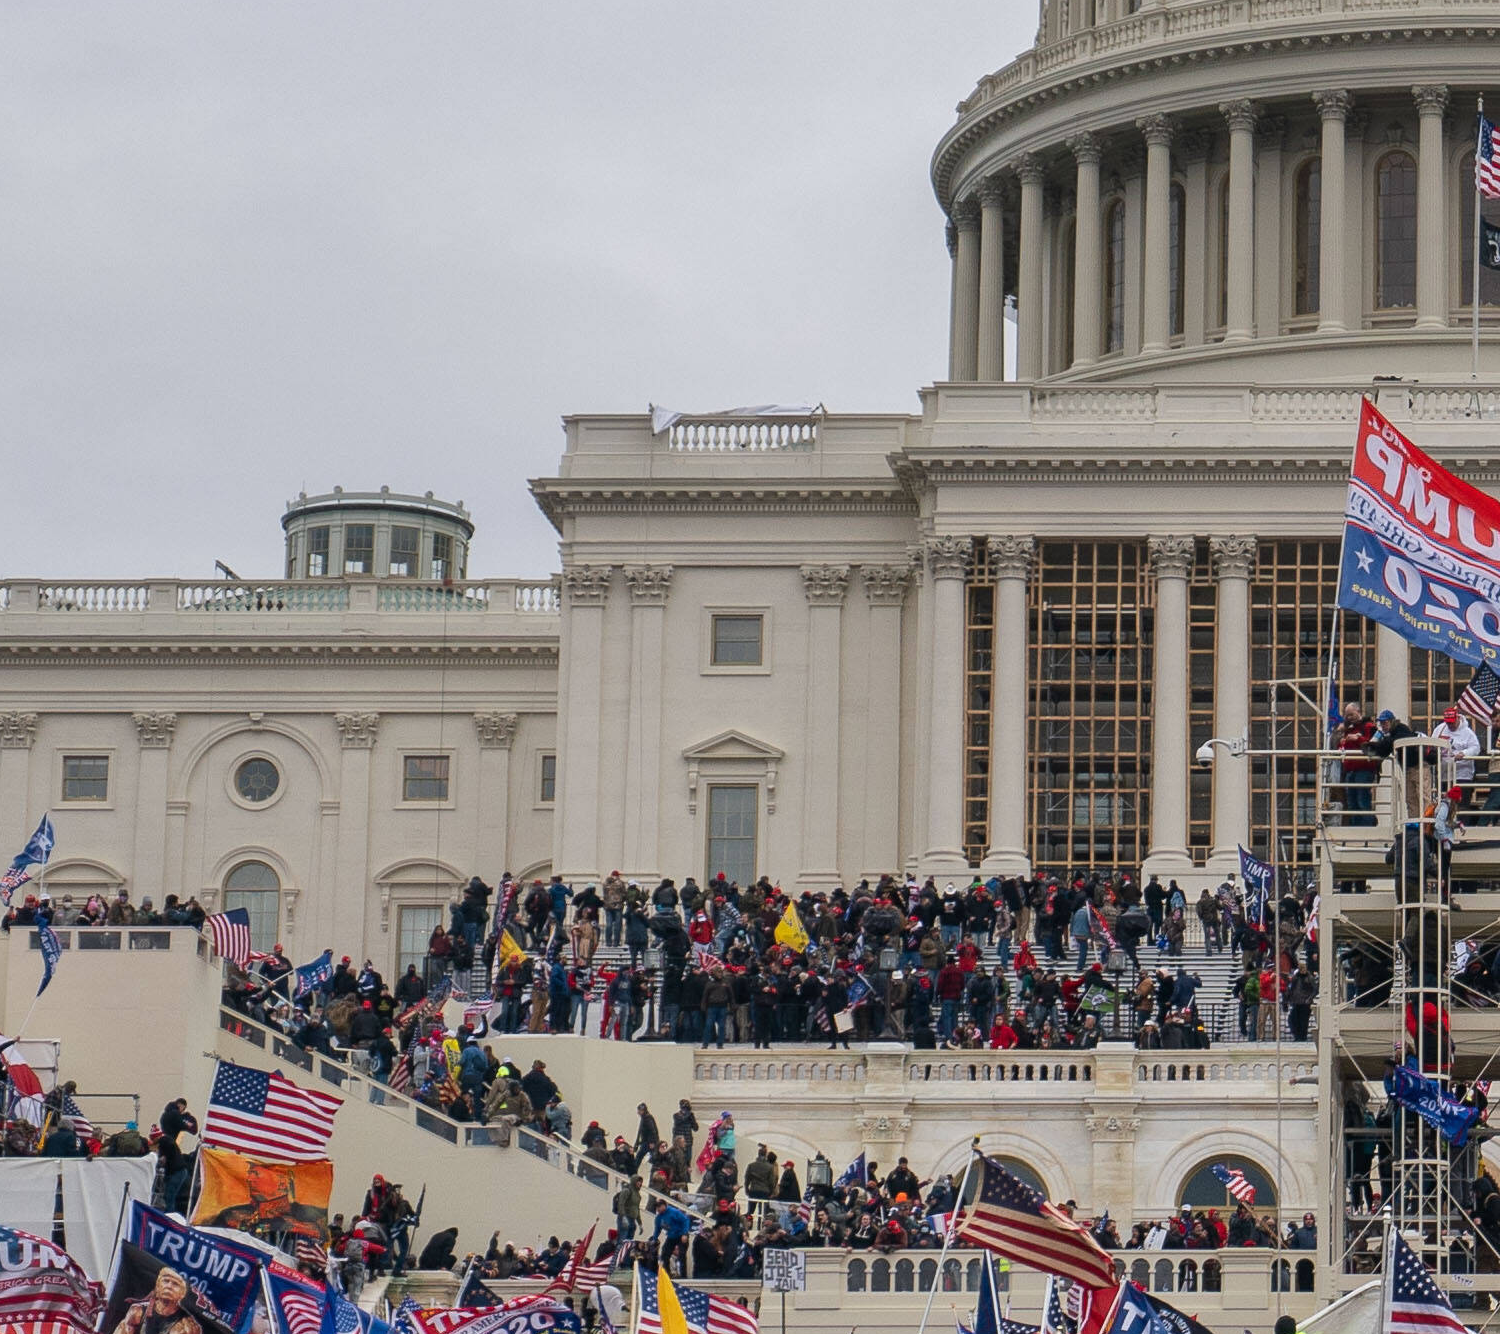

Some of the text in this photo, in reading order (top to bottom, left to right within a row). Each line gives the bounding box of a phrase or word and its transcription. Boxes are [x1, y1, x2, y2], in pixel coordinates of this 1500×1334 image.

[147, 1220, 250, 1285] TRUMP
[766, 1249, 798, 1266] SEND
[34, 1276, 70, 1286] GREA
